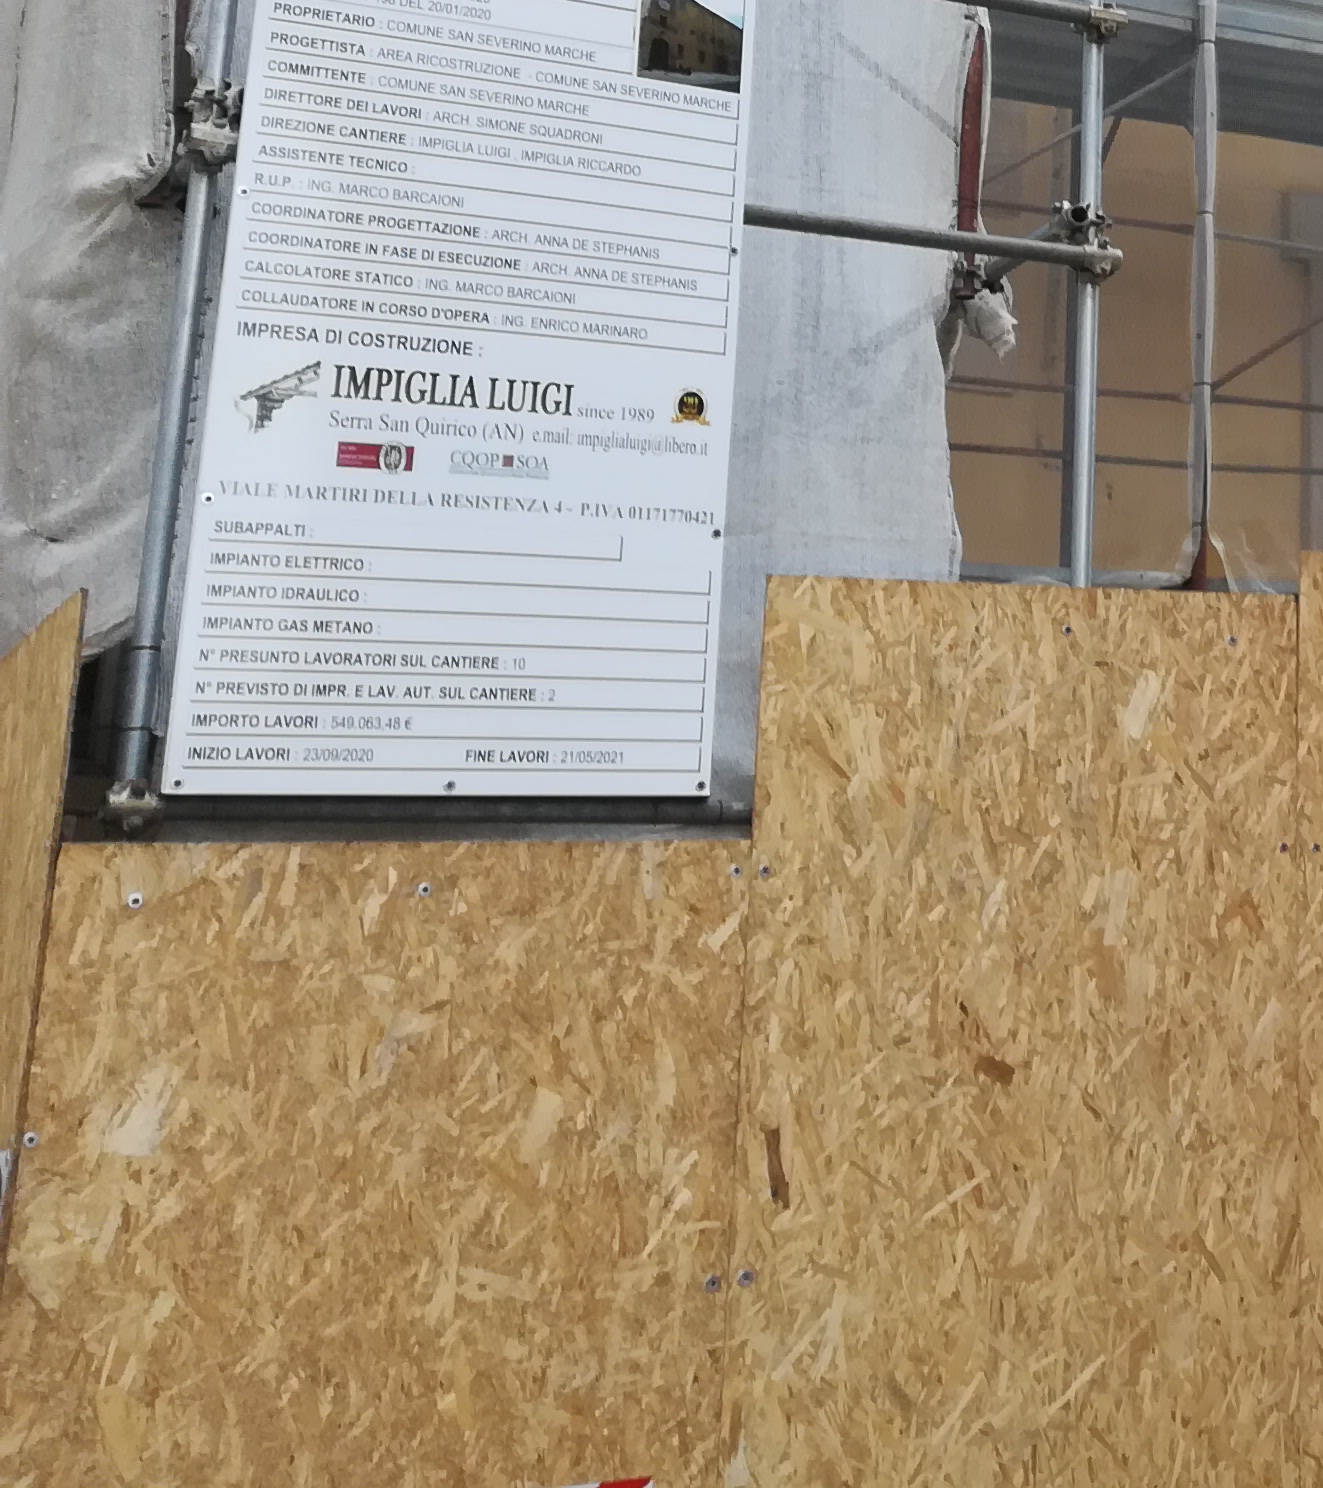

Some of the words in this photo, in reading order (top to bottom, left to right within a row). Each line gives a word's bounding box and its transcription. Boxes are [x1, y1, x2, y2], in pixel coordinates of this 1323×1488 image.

[428, 0, 491, 21] 20/01/2020
[272, 0, 375, 28] PROPRIETARIO
[386, 18, 443, 39] COMUNE
[446, 28, 473, 44] SAN
[477, 33, 541, 55] SEVERINO
[544, 44, 596, 64] MARCHE
[267, 58, 366, 84] COMMITTENTE
[377, 74, 436, 95] COMUNE
[439, 83, 466, 99] SAN
[468, 88, 534, 109] SEVERINO
[537, 98, 589, 117] MARCHE
[269, 29, 366, 56] PROGETTISTA
[376, 46, 412, 64] AREA
[415, 52, 520, 80] RICOSTRUZIONE
[535, 71, 589, 91] COMUNE
[592, 80, 617, 95] SAN
[619, 84, 680, 105] SEVERINO
[682, 94, 731, 113] MARCHE
[264, 85, 343, 108] DIRETTORE
[345, 97, 369, 112] DEI
[371, 101, 421, 120] LAVORI
[476, 116, 525, 134] SIMONE
[528, 123, 602, 145] SQUADRONI
[258, 142, 344, 166] ASSISTENTE
[347, 154, 408, 174] TECNICO
[260, 113, 334, 135] DIREZIONE
[339, 124, 406, 145] CANTIERE
[417, 135, 474, 155] IMPIGLIA
[477, 143, 510, 160] LUIGI
[520, 149, 574, 168] IMPIGLIA
[577, 157, 641, 178] RICCARDO
[338, 181, 389, 200] MARCO
[392, 188, 464, 209] BARCAIONI
[251, 199, 364, 225] COORDINATORE
[368, 213, 480, 239] PROGETTAZIONE
[534, 233, 569, 250] ANNA
[572, 238, 588, 252] DE
[591, 240, 660, 261] STEPHANIS
[247, 228, 361, 254] COORDINATORE
[364, 241, 380, 256] IN
[382, 243, 418, 260] FASE
[437, 250, 520, 272] ESECUZIONE
[573, 265, 607, 282] ANNA
[610, 270, 628, 284] DE
[631, 272, 697, 292] STEPHANIS
[244, 257, 351, 281] CALCOLATORE
[354, 269, 413, 288] STATICO
[454, 280, 503, 298] MARCO
[506, 286, 576, 306] BARCAIONI
[240, 286, 357, 311] COLLAUDATORE
[360, 299, 374, 313] IN
[377, 301, 428, 318] CORSO
[430, 306, 490, 325] D'OPERA
[530, 317, 579, 334] ENRICO
[582, 322, 648, 341] MARINARO
[236, 319, 319, 342] IMPRESA
[324, 327, 343, 344] DI
[347, 330, 473, 357] COSTRUZIONE
[331, 363, 480, 409] IMPIGLIA
[485, 377, 574, 417] LUIGI
[576, 403, 614, 419] since
[620, 405, 654, 423] 1989
[328, 409, 374, 429] Serra
[378, 413, 410, 432] San
[414, 416, 478, 440] Quirico
[482, 421, 525, 445] (AN)
[217, 479, 277, 498] VIALE
[284, 483, 368, 503] MARTIRI
[372, 489, 435, 508] DELLA
[440, 494, 550, 515] RESISTENZA
[213, 519, 306, 537] SUBAPPALTI
[209, 551, 280, 567] IMPIANTO
[284, 555, 364, 572] ELETTRICO
[206, 582, 277, 599] IMPIANTO
[280, 586, 360, 603] IDRAULICO
[202, 615, 273, 631] IMPIANTO
[277, 618, 309, 633] GAS
[312, 619, 373, 635] METANO
[219, 647, 300, 664] PRESUNTO
[303, 650, 395, 667] LAVORATORI
[400, 653, 427, 668] SUL
[431, 654, 499, 670] CANTIERE
[512, 657, 526, 671] 10
[216, 680, 289, 697] PREVISTO
[293, 682, 308, 697] DI
[438, 686, 464, 701] SUL
[469, 687, 536, 703] CANTIERE
[190, 712, 259, 728] IMPORTO
[264, 714, 318, 729] LAVORI
[186, 745, 231, 761] INIZIO
[235, 746, 290, 761] LAVORI
[464, 749, 496, 764] FINE
[500, 750, 549, 764] LAVORI
